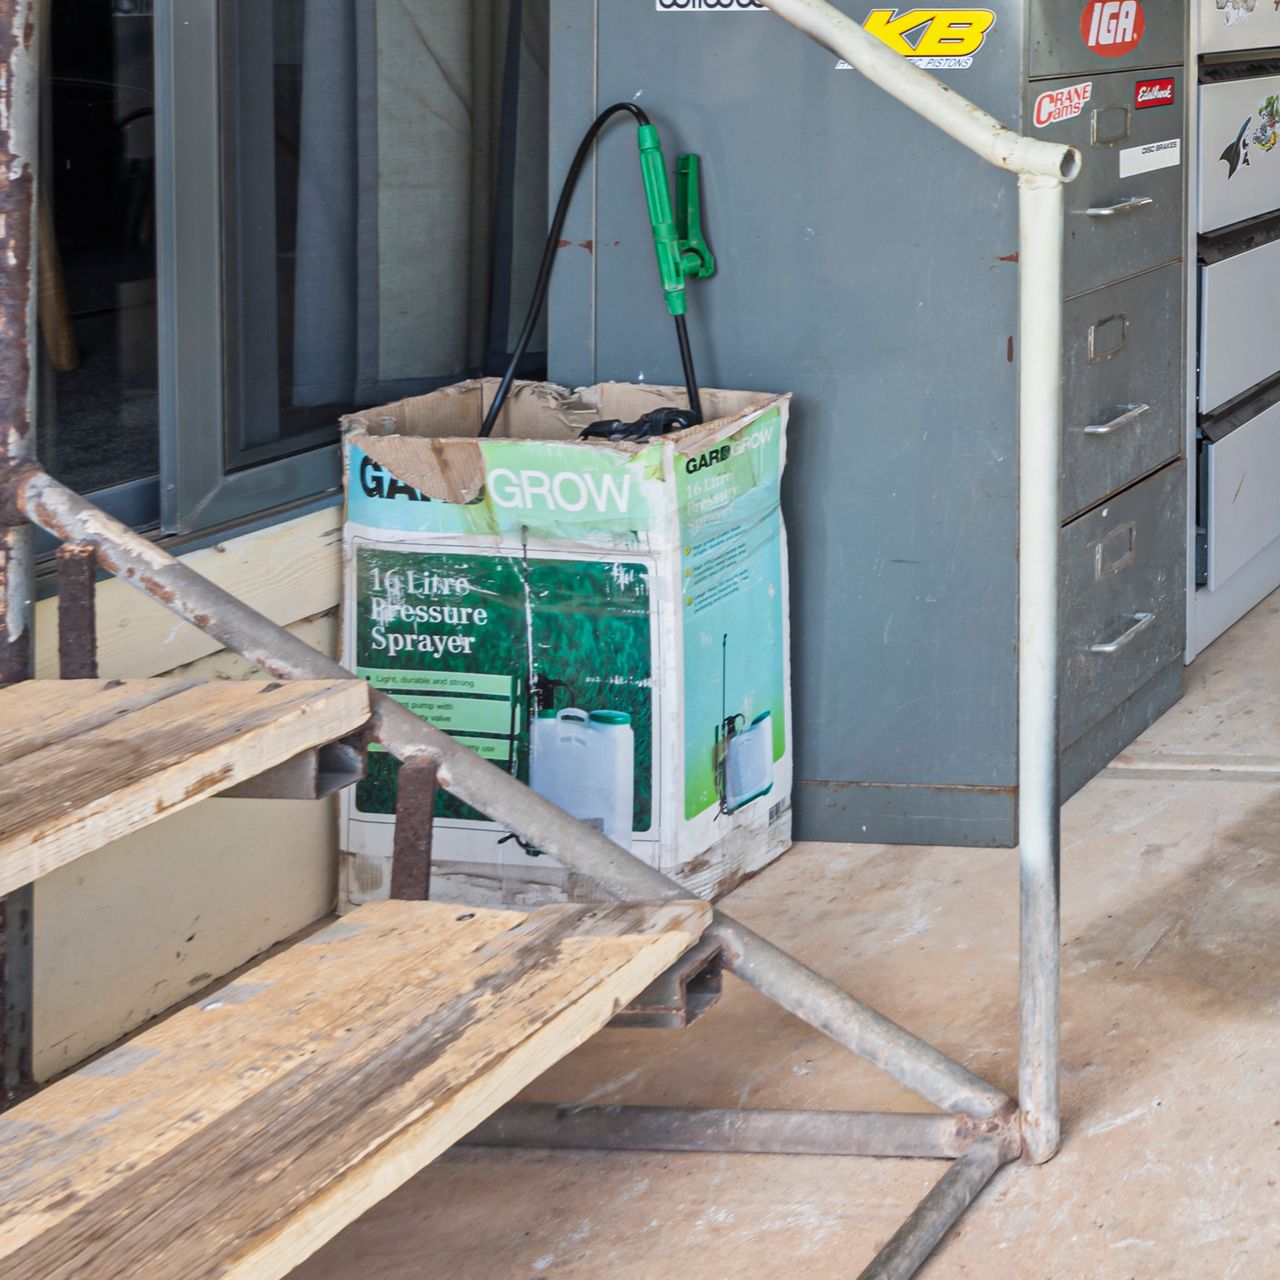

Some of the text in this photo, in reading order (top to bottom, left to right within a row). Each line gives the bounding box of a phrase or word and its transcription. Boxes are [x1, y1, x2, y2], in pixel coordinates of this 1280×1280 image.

[863, 9, 996, 58] KB
[1088, 0, 1137, 47] IGA
[925, 58, 971, 68] PISTONS
[1137, 85, 1173, 102] Edelbrock
[686, 444, 731, 474] GARD
[487, 468, 632, 513] GROW
[371, 567, 470, 596] 16 Litre
[371, 597, 488, 625] Pressure
[371, 626, 476, 659] Sprayer
[400, 675, 430, 684] durable
[433, 677, 448, 685] and
[449, 679, 475, 688] strong
[411, 702, 435, 711] pump
[436, 703, 453, 711] with
